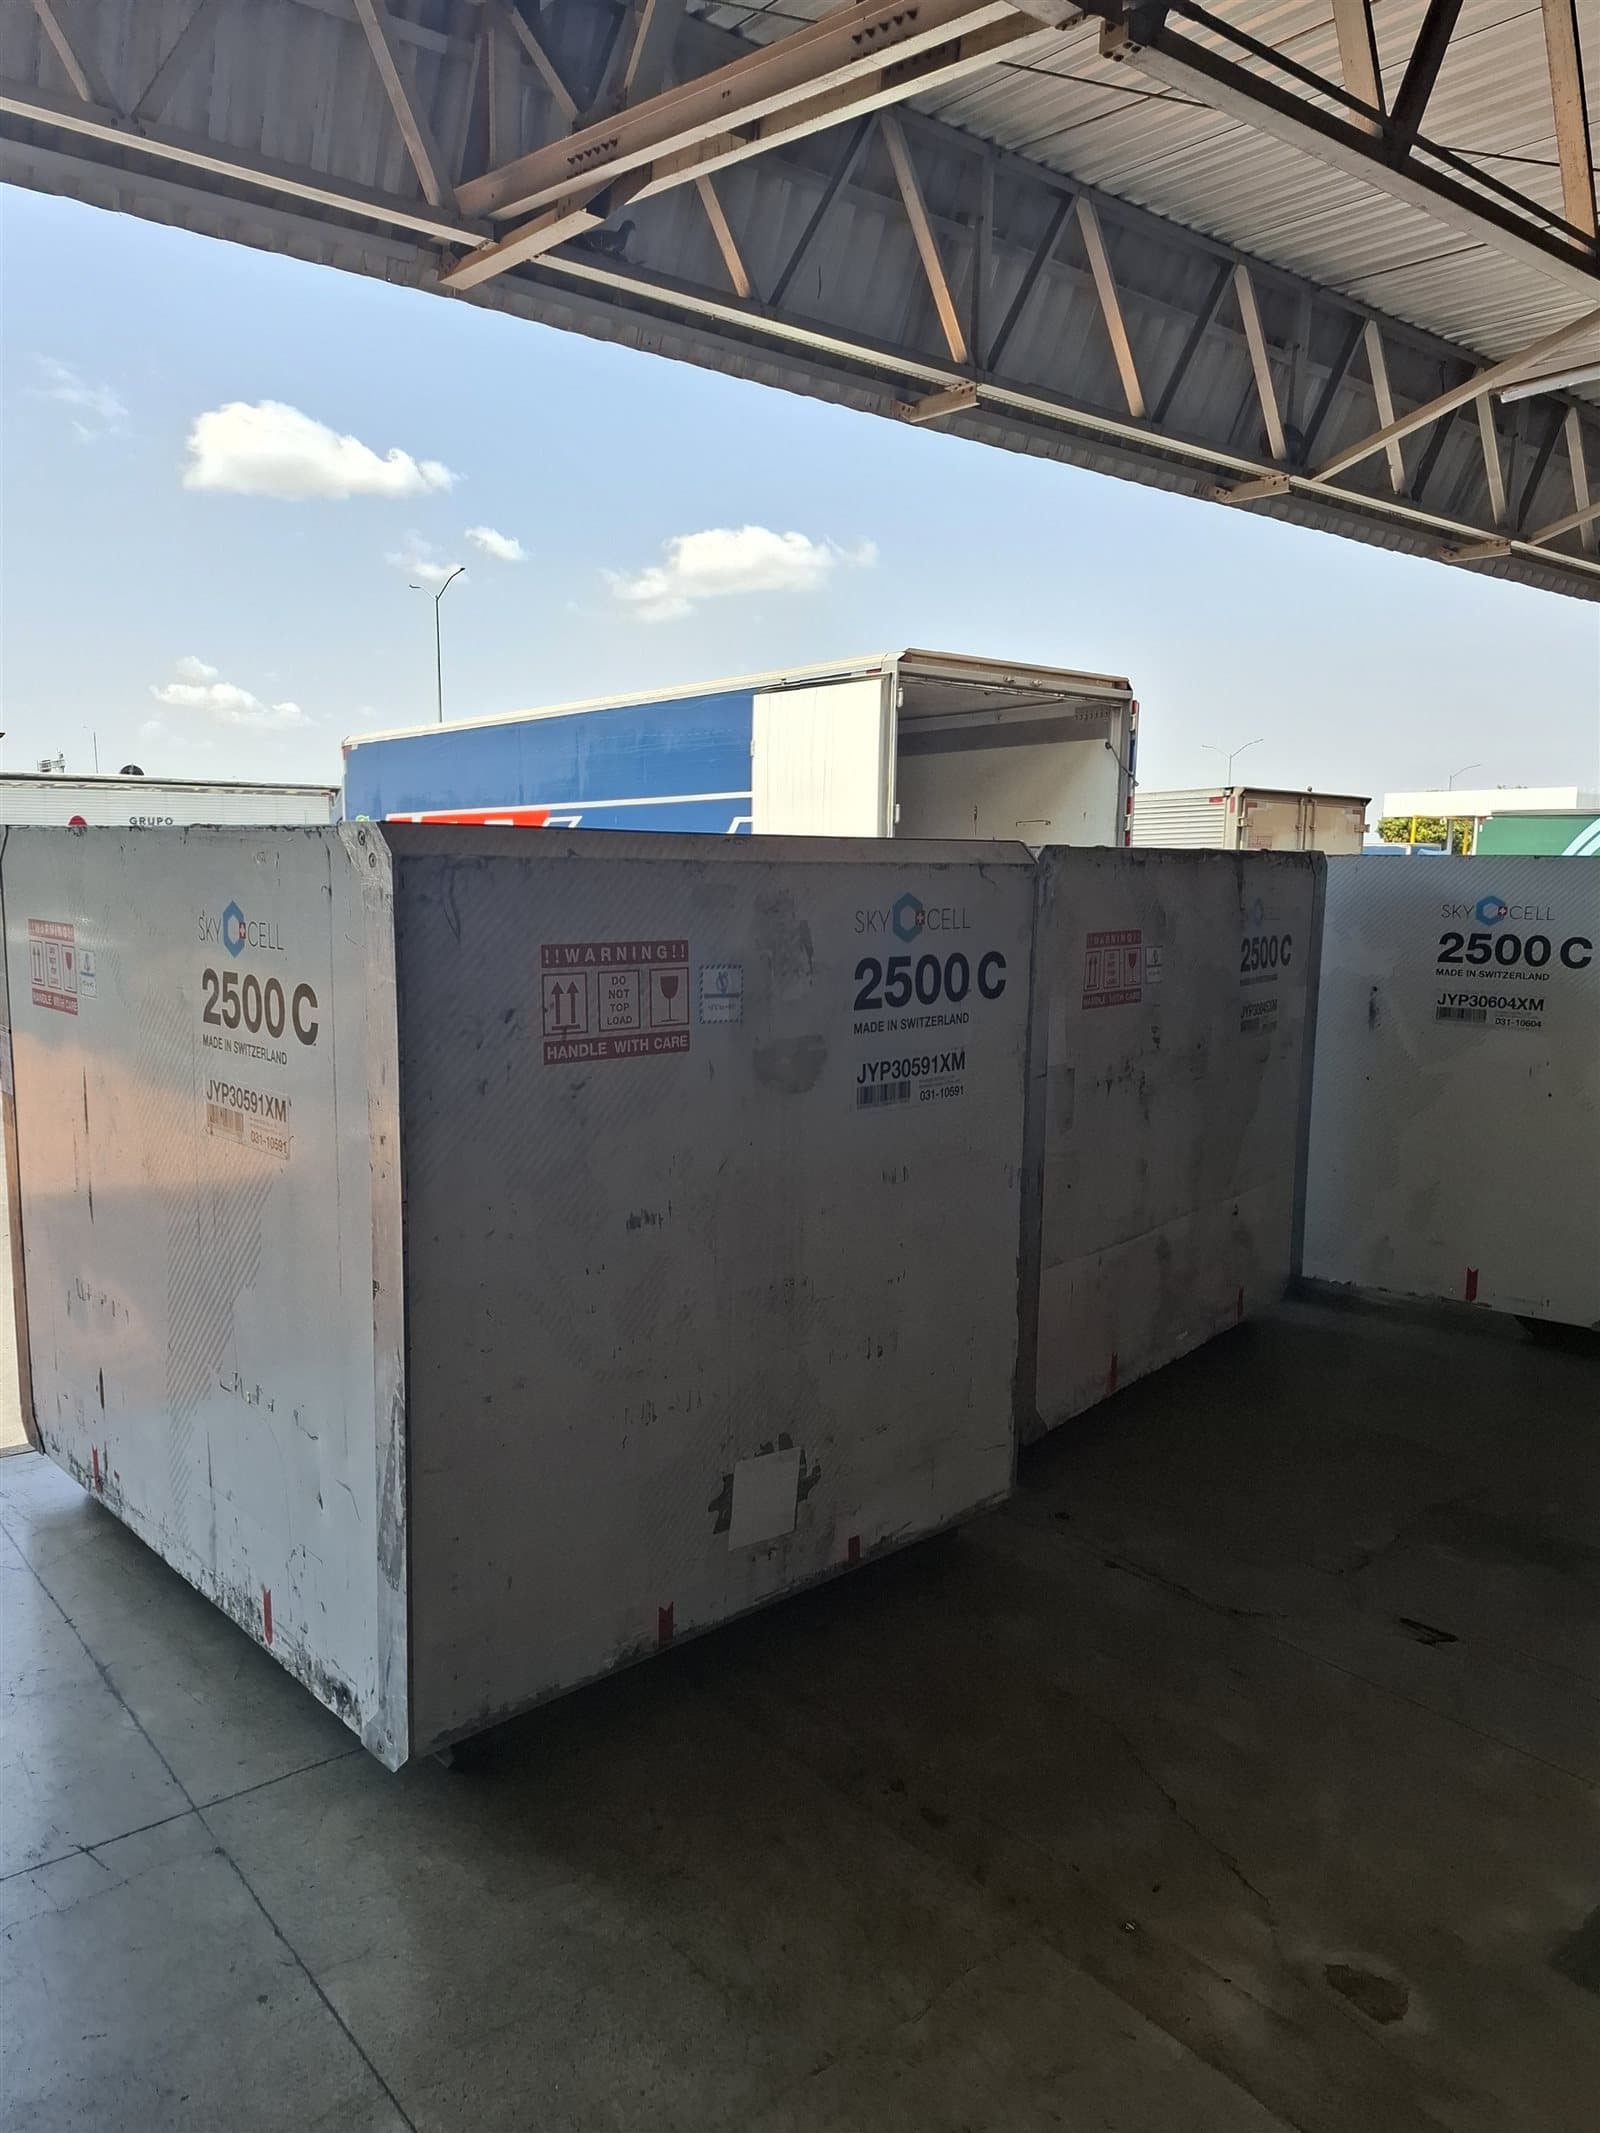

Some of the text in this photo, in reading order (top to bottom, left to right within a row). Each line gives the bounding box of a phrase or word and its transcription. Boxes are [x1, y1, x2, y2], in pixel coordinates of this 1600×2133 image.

[129, 816, 173, 826] GRUPO
[855, 907, 971, 933] SKY CELL
[1440, 904, 1555, 921] SKY CELL
[199, 914, 284, 951] SKY CELL
[544, 943, 686, 965] !!WARNING!!
[1240, 934, 1292, 972] 2500 C
[1437, 932, 1593, 969] 2500 C
[611, 976, 626, 986] DO
[854, 951, 1007, 1011] 2500 C
[1436, 968, 1550, 981] MADE IN SWITZERLAND
[608, 989, 630, 999] NOT
[1437, 993, 1544, 1011] JYP30604XM
[202, 968, 318, 1046] 2500 C
[609, 1003, 630, 1013] TOP
[607, 1016, 633, 1025] LOAD
[853, 1012, 970, 1035] MADE IN SWITZERLAND
[203, 1034, 287, 1065] MADE IN SWITZERLAND
[546, 1035, 689, 1060] HANDLE WITH CARE
[857, 1050, 966, 1084] JYP30591XM
[207, 1079, 287, 1122] JYP30591XM
